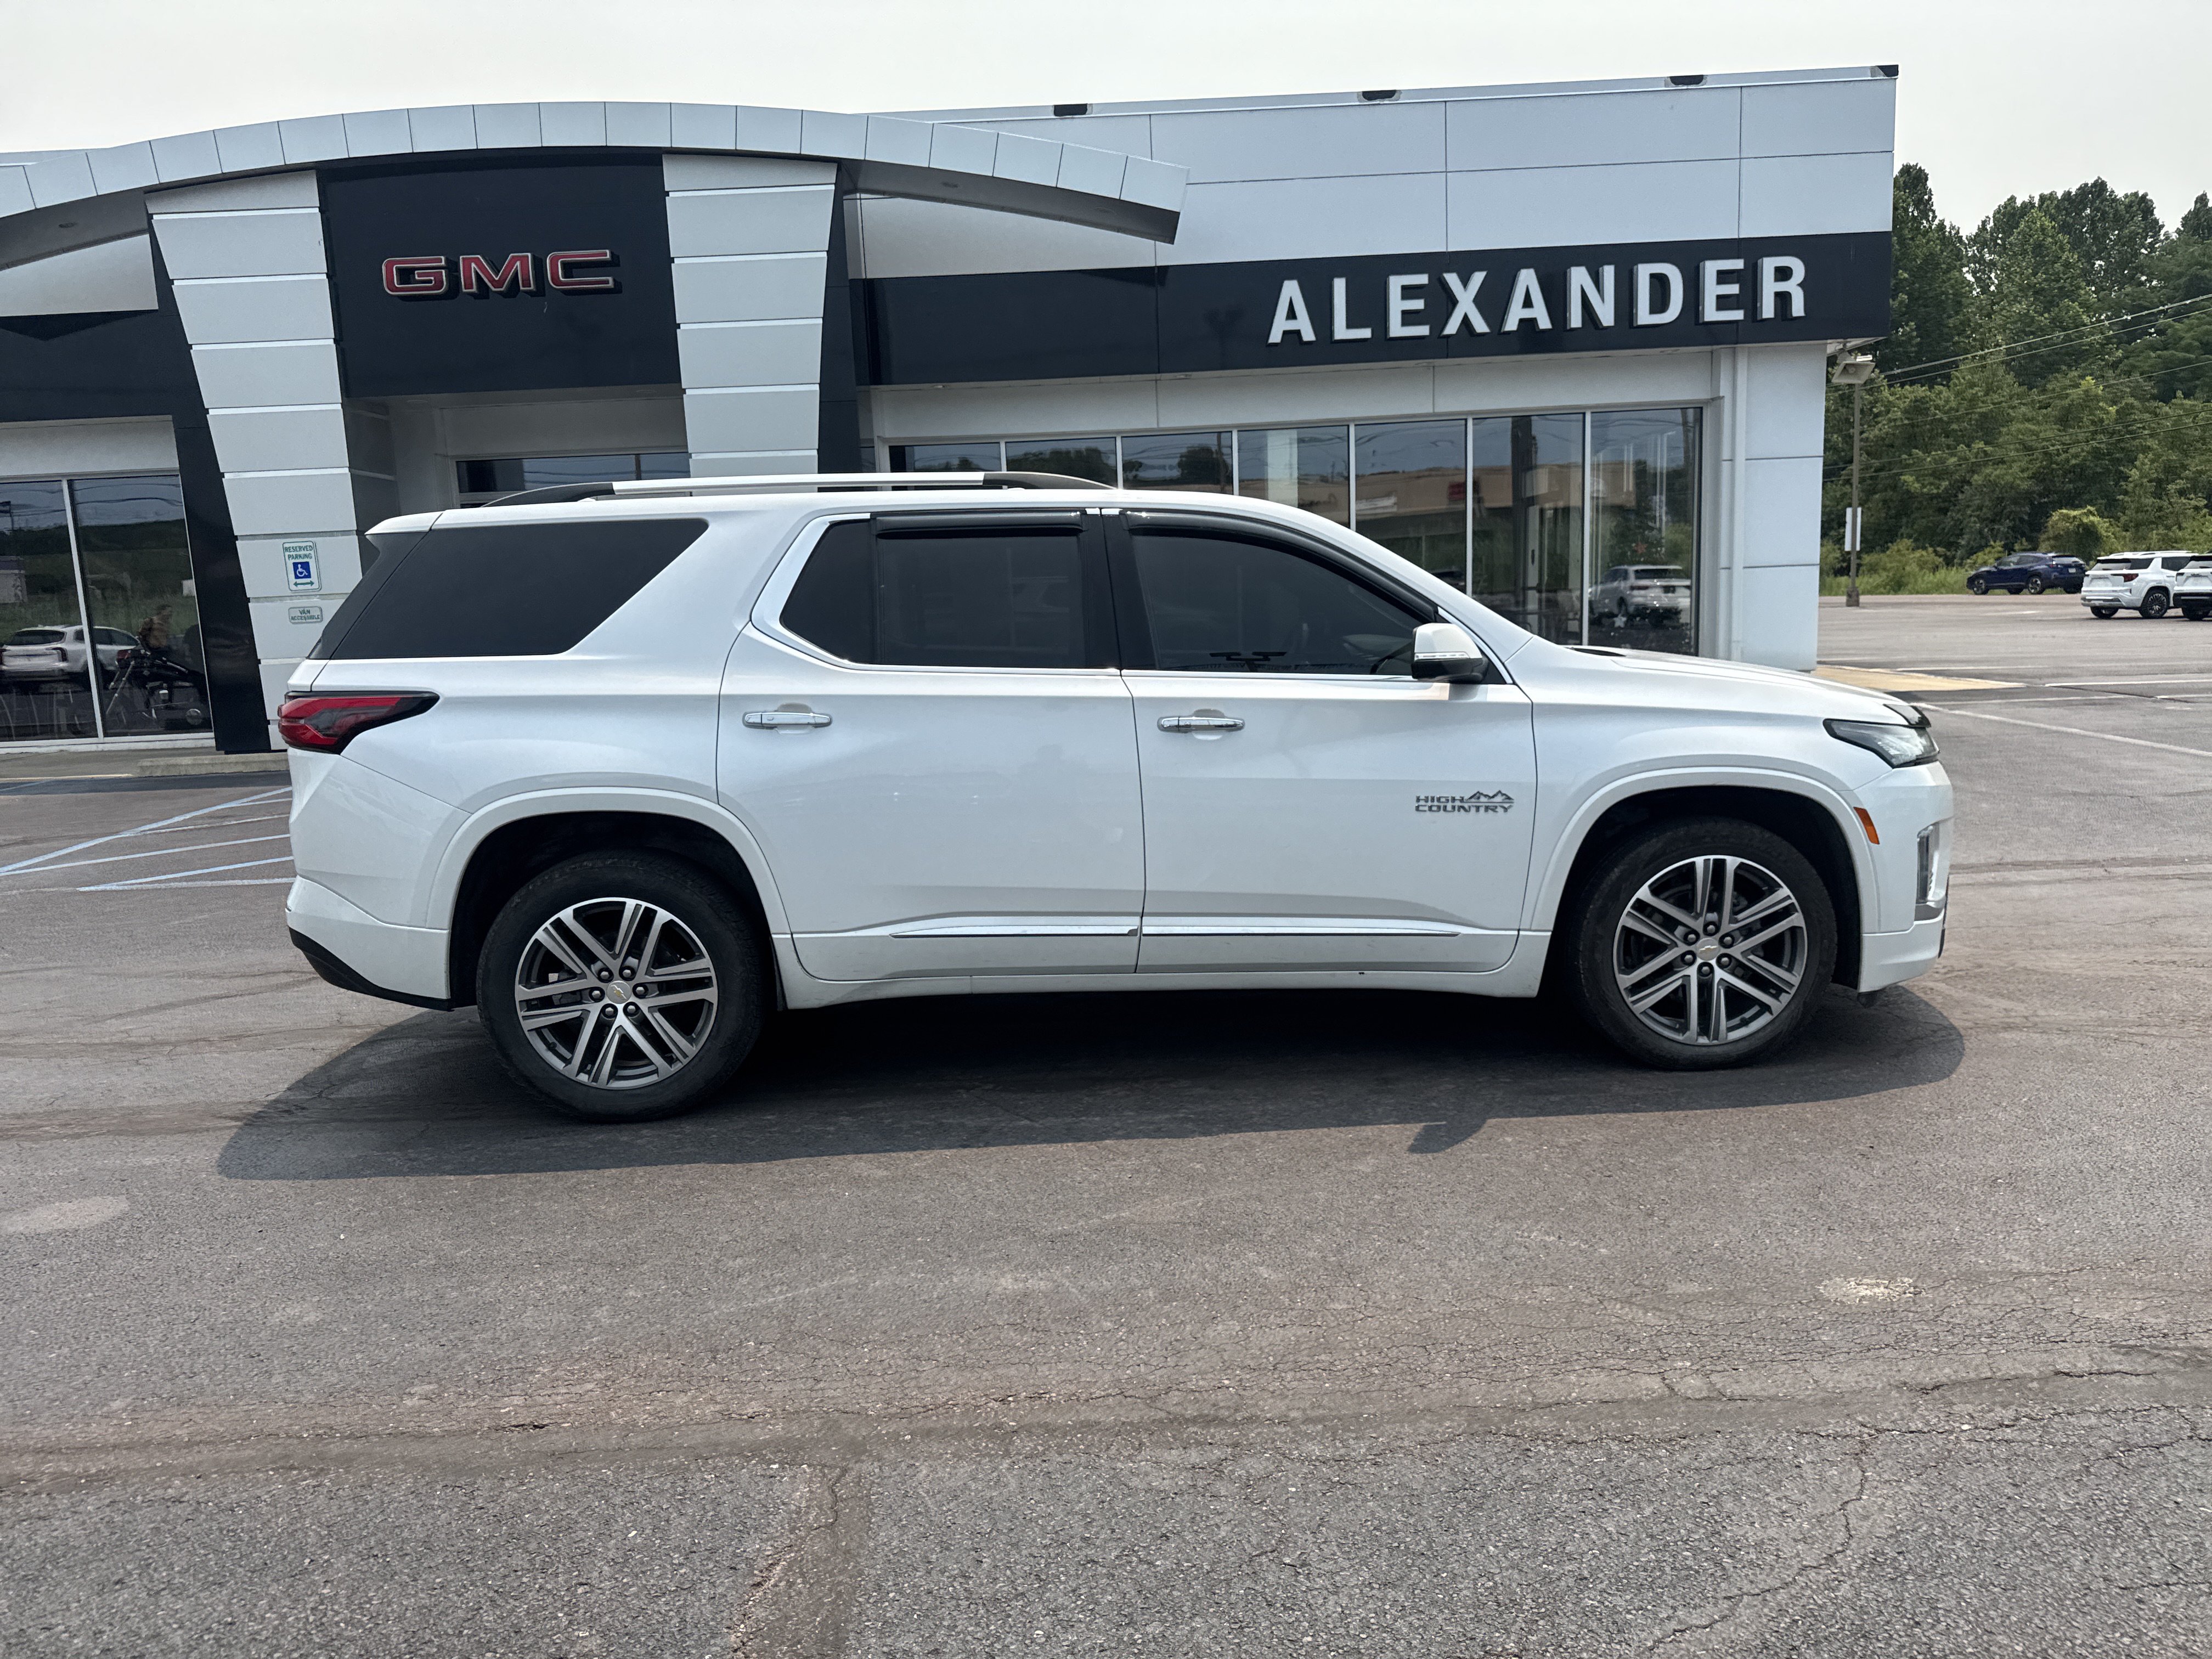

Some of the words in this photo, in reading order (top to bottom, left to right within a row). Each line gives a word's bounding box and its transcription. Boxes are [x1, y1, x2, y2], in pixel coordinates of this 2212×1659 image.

[382, 250, 614, 295] GMC
[1267, 256, 1807, 346] ALEXANDER
[1415, 804, 1514, 812] COUNTRY
